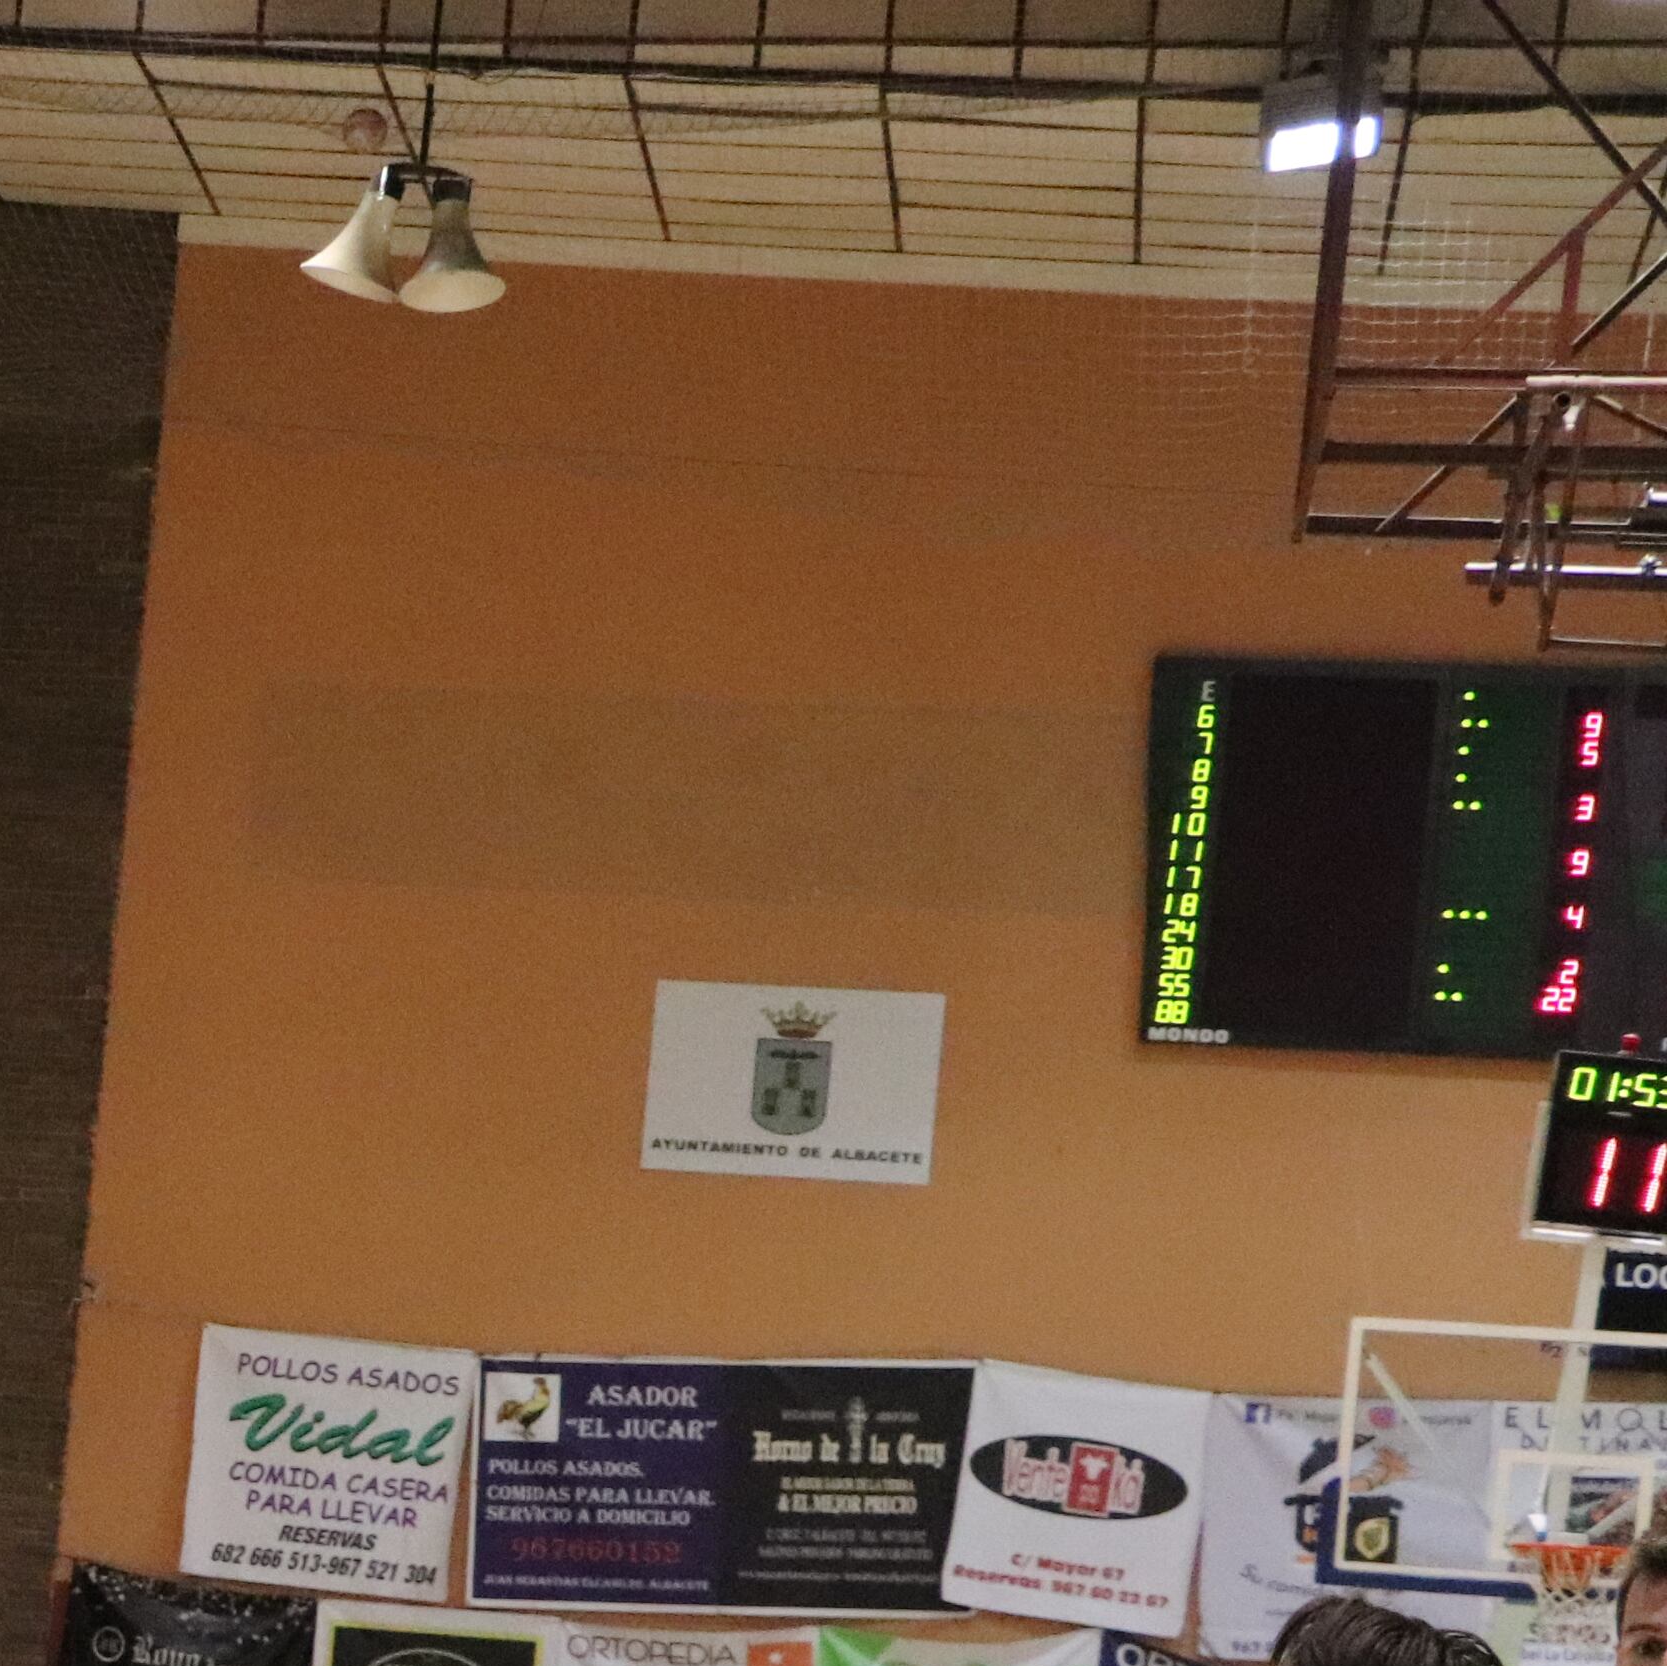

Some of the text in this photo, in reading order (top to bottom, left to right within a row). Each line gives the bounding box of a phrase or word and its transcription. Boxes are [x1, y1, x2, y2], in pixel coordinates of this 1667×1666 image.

[1201, 680, 1216, 702] E
[1196, 704, 1216, 729] 6
[1584, 712, 1603, 738] 9
[1198, 732, 1215, 755] 7
[1580, 741, 1599, 767] 5
[1192, 759, 1211, 783] 8
[1191, 785, 1208, 810] 9
[1575, 794, 1595, 821] 3
[1172, 812, 1206, 836] 10
[1169, 839, 1204, 862] 11
[1571, 850, 1590, 876] 9
[1167, 866, 1202, 889] 17
[1164, 892, 1199, 917] 18
[1566, 906, 1584, 929] 4
[1161, 919, 1197, 943] 24
[1160, 946, 1194, 971] 30
[1560, 960, 1579, 984] 2
[1158, 972, 1190, 998] 55
[1154, 1000, 1189, 1024] 88
[1541, 987, 1577, 1013] 22
[1148, 1027, 1230, 1044] MONDO
[652, 1137, 923, 1165] AYUNTAMIENTO DE ALBACETE
[238, 1353, 460, 1396] POLLOS ASADOS
[587, 1384, 698, 1408] ASADOR
[229, 1393, 455, 1467] Vidal
[487, 1459, 558, 1475] POLLOS
[229, 1461, 449, 1504] COMIDA CASERA
[486, 1485, 570, 1502] COMIDAS
[575, 1487, 629, 1504] PARA
[245, 1490, 418, 1529] PARA LLEVAR
[485, 1505, 691, 1526] SERVICIO A DOMICILIO
[279, 1525, 378, 1551] RESERVAS
[1037, 1557, 1098, 1577] Mayor
[568, 1634, 736, 1666] ORTOPEDIA
